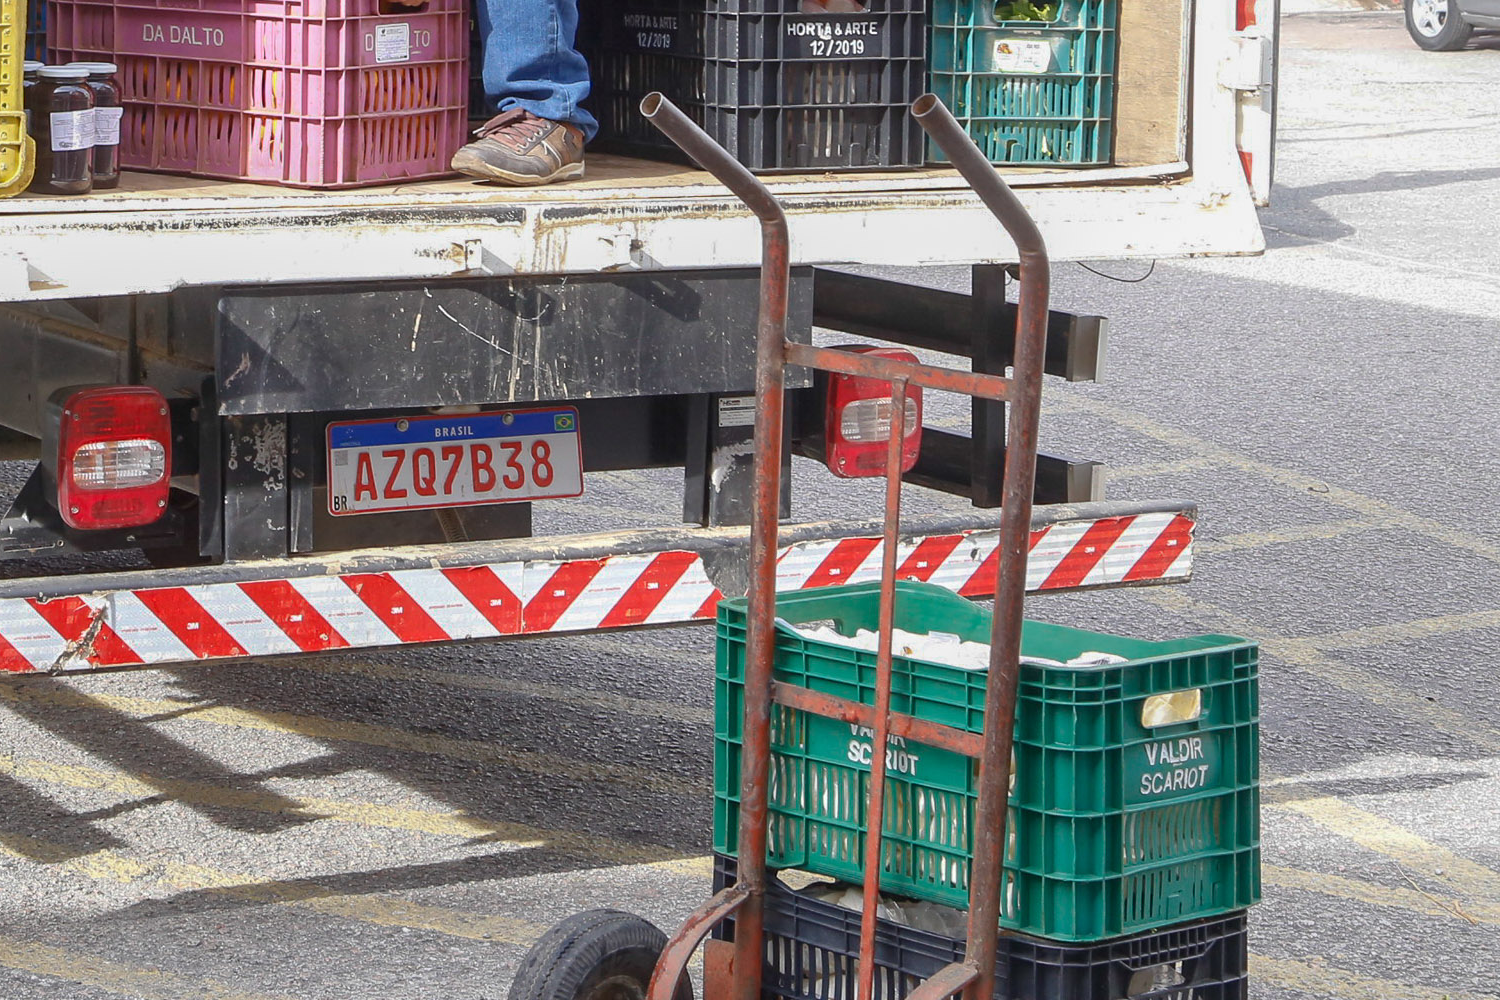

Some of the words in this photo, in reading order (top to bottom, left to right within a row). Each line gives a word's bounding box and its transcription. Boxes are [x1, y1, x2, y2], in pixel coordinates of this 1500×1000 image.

[624, 14, 652, 28] HORTA
[652, 15, 658, 28] &
[659, 15, 678, 29] ARTE
[787, 22, 832, 36] HORTA
[834, 22, 843, 36] &
[844, 22, 878, 36] ARTE
[142, 23, 165, 42] DA
[170, 25, 224, 46] DALTO
[637, 32, 671, 48] 12/2019
[809, 39, 865, 56] 12/2019
[434, 426, 474, 437] BRASIL
[354, 440, 554, 502] AZQ7B38
[333, 495, 348, 510] BR
[390, 606, 403, 614] 3M
[290, 614, 302, 622] 3M
[186, 622, 199, 630] 3M
[847, 740, 919, 776] SCRIOT
[1144, 737, 1204, 765] VALDIR
[1140, 765, 1209, 794] SCARIOT
